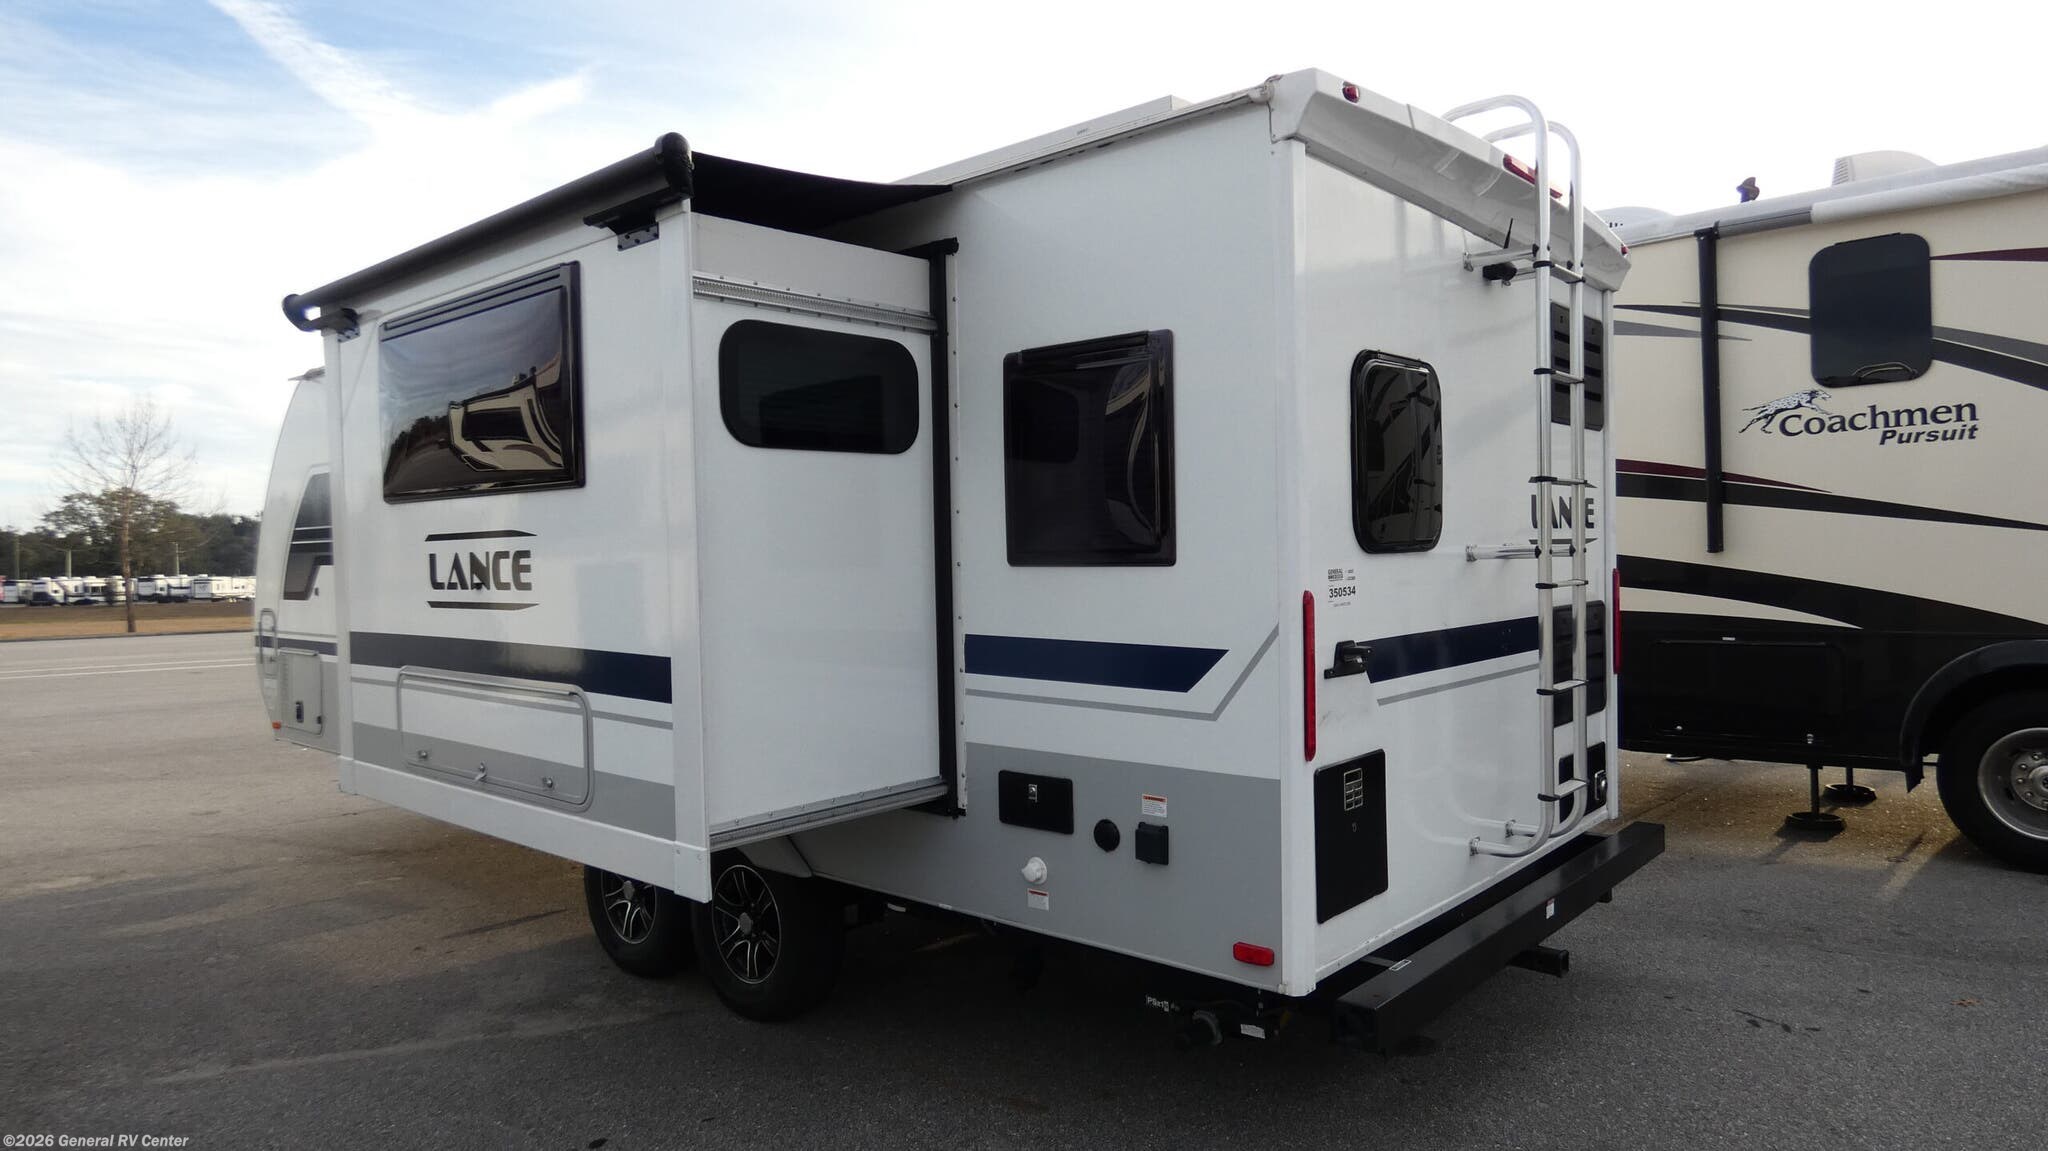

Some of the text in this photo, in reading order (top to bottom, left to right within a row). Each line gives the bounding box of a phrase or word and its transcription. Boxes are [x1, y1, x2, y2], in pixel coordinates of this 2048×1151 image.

[1779, 403, 1979, 437] Coachmen
[1879, 424, 1979, 446] Pursuit
[1531, 495, 1595, 529] LNE
[428, 550, 532, 591] LANCE
[1328, 585, 1356, 598] 350534
